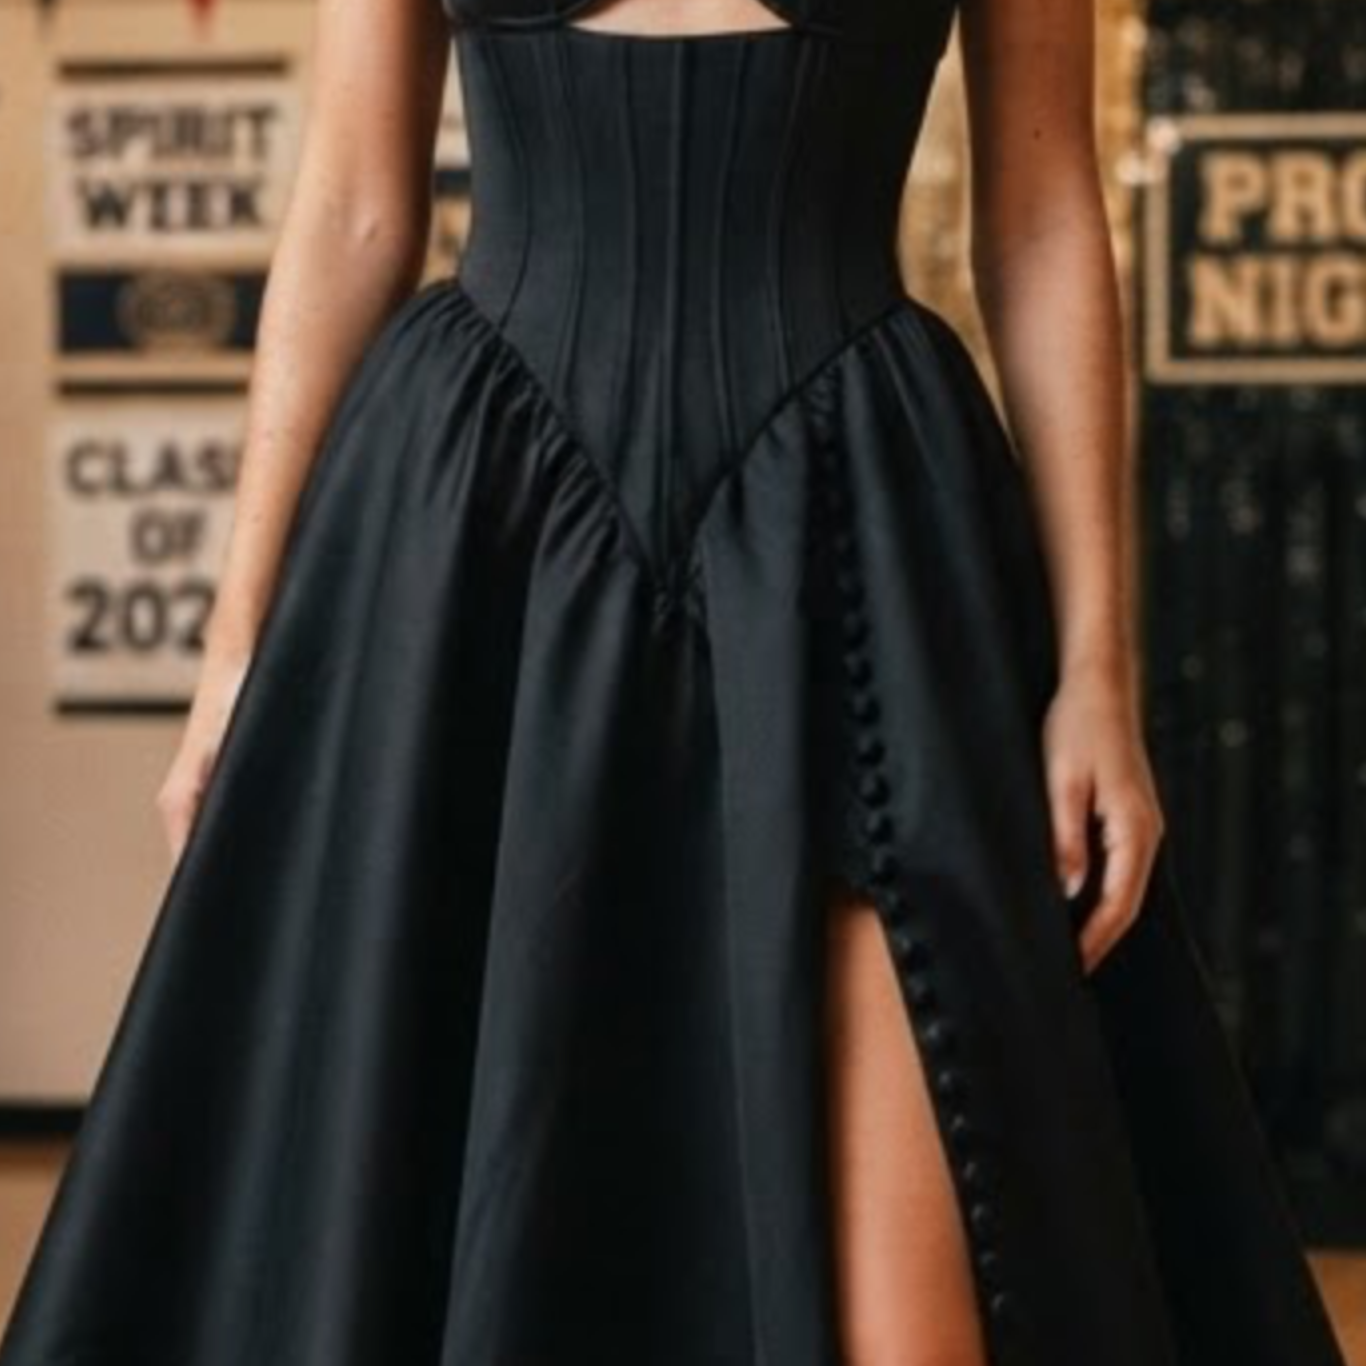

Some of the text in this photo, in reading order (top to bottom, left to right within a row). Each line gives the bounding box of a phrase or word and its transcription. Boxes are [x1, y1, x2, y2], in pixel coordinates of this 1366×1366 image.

[66, 104, 276, 161] SPIRIT
[79, 180, 261, 231] WEEK
[65, 441, 244, 498] CLAS
[65, 579, 217, 655] 202
